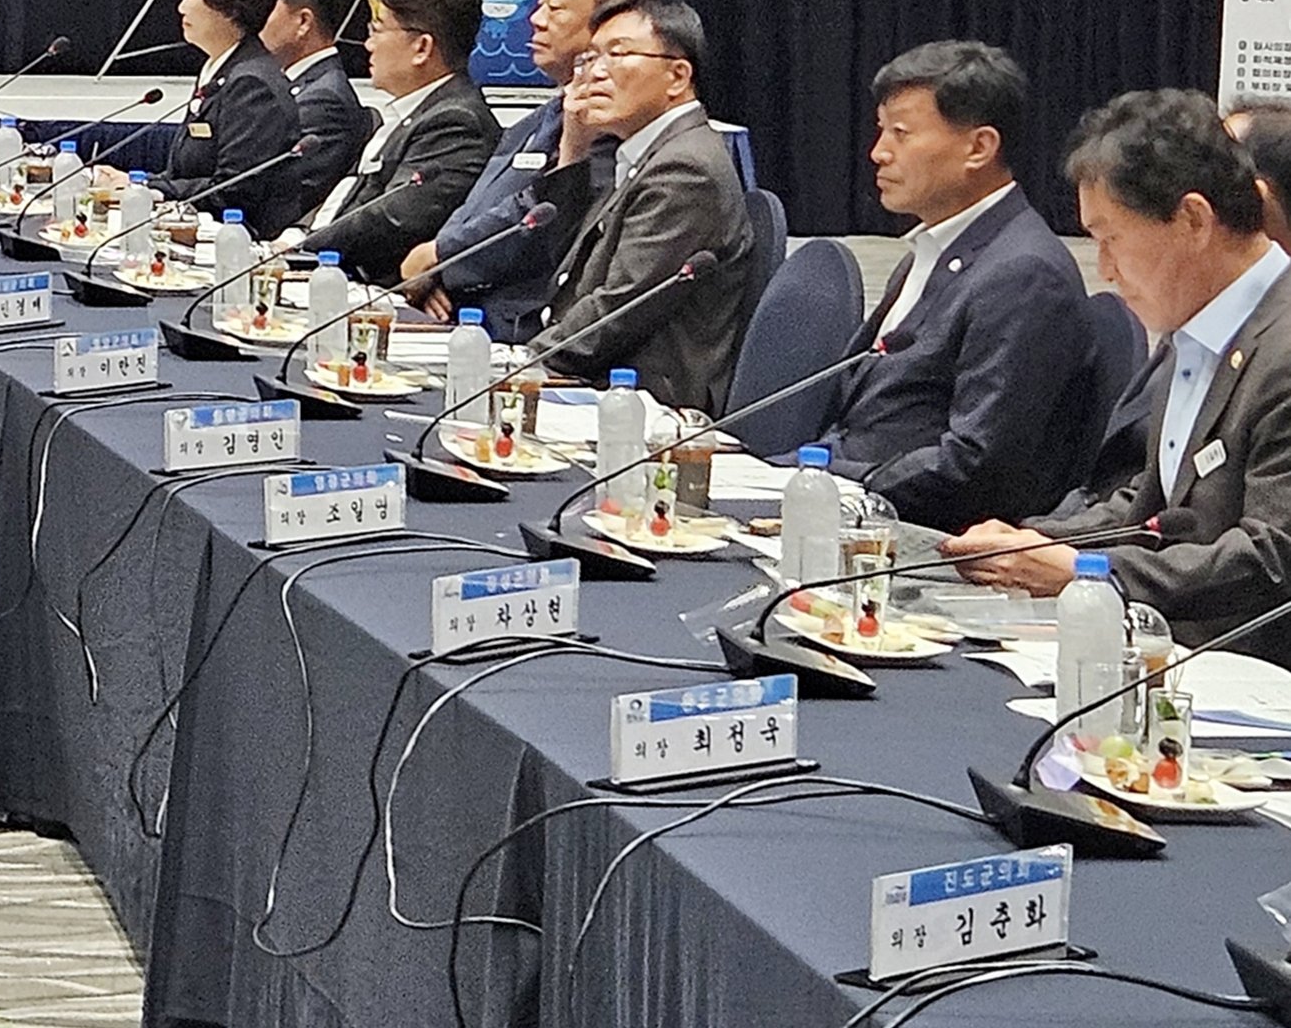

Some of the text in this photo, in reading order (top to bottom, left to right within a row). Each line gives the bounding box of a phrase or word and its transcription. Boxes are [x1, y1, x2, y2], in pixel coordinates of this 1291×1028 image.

[222, 428, 284, 455] 김영인
[634, 715, 781, 759] 의장 최정욱
[890, 893, 1048, 950] 의장 김춘화
